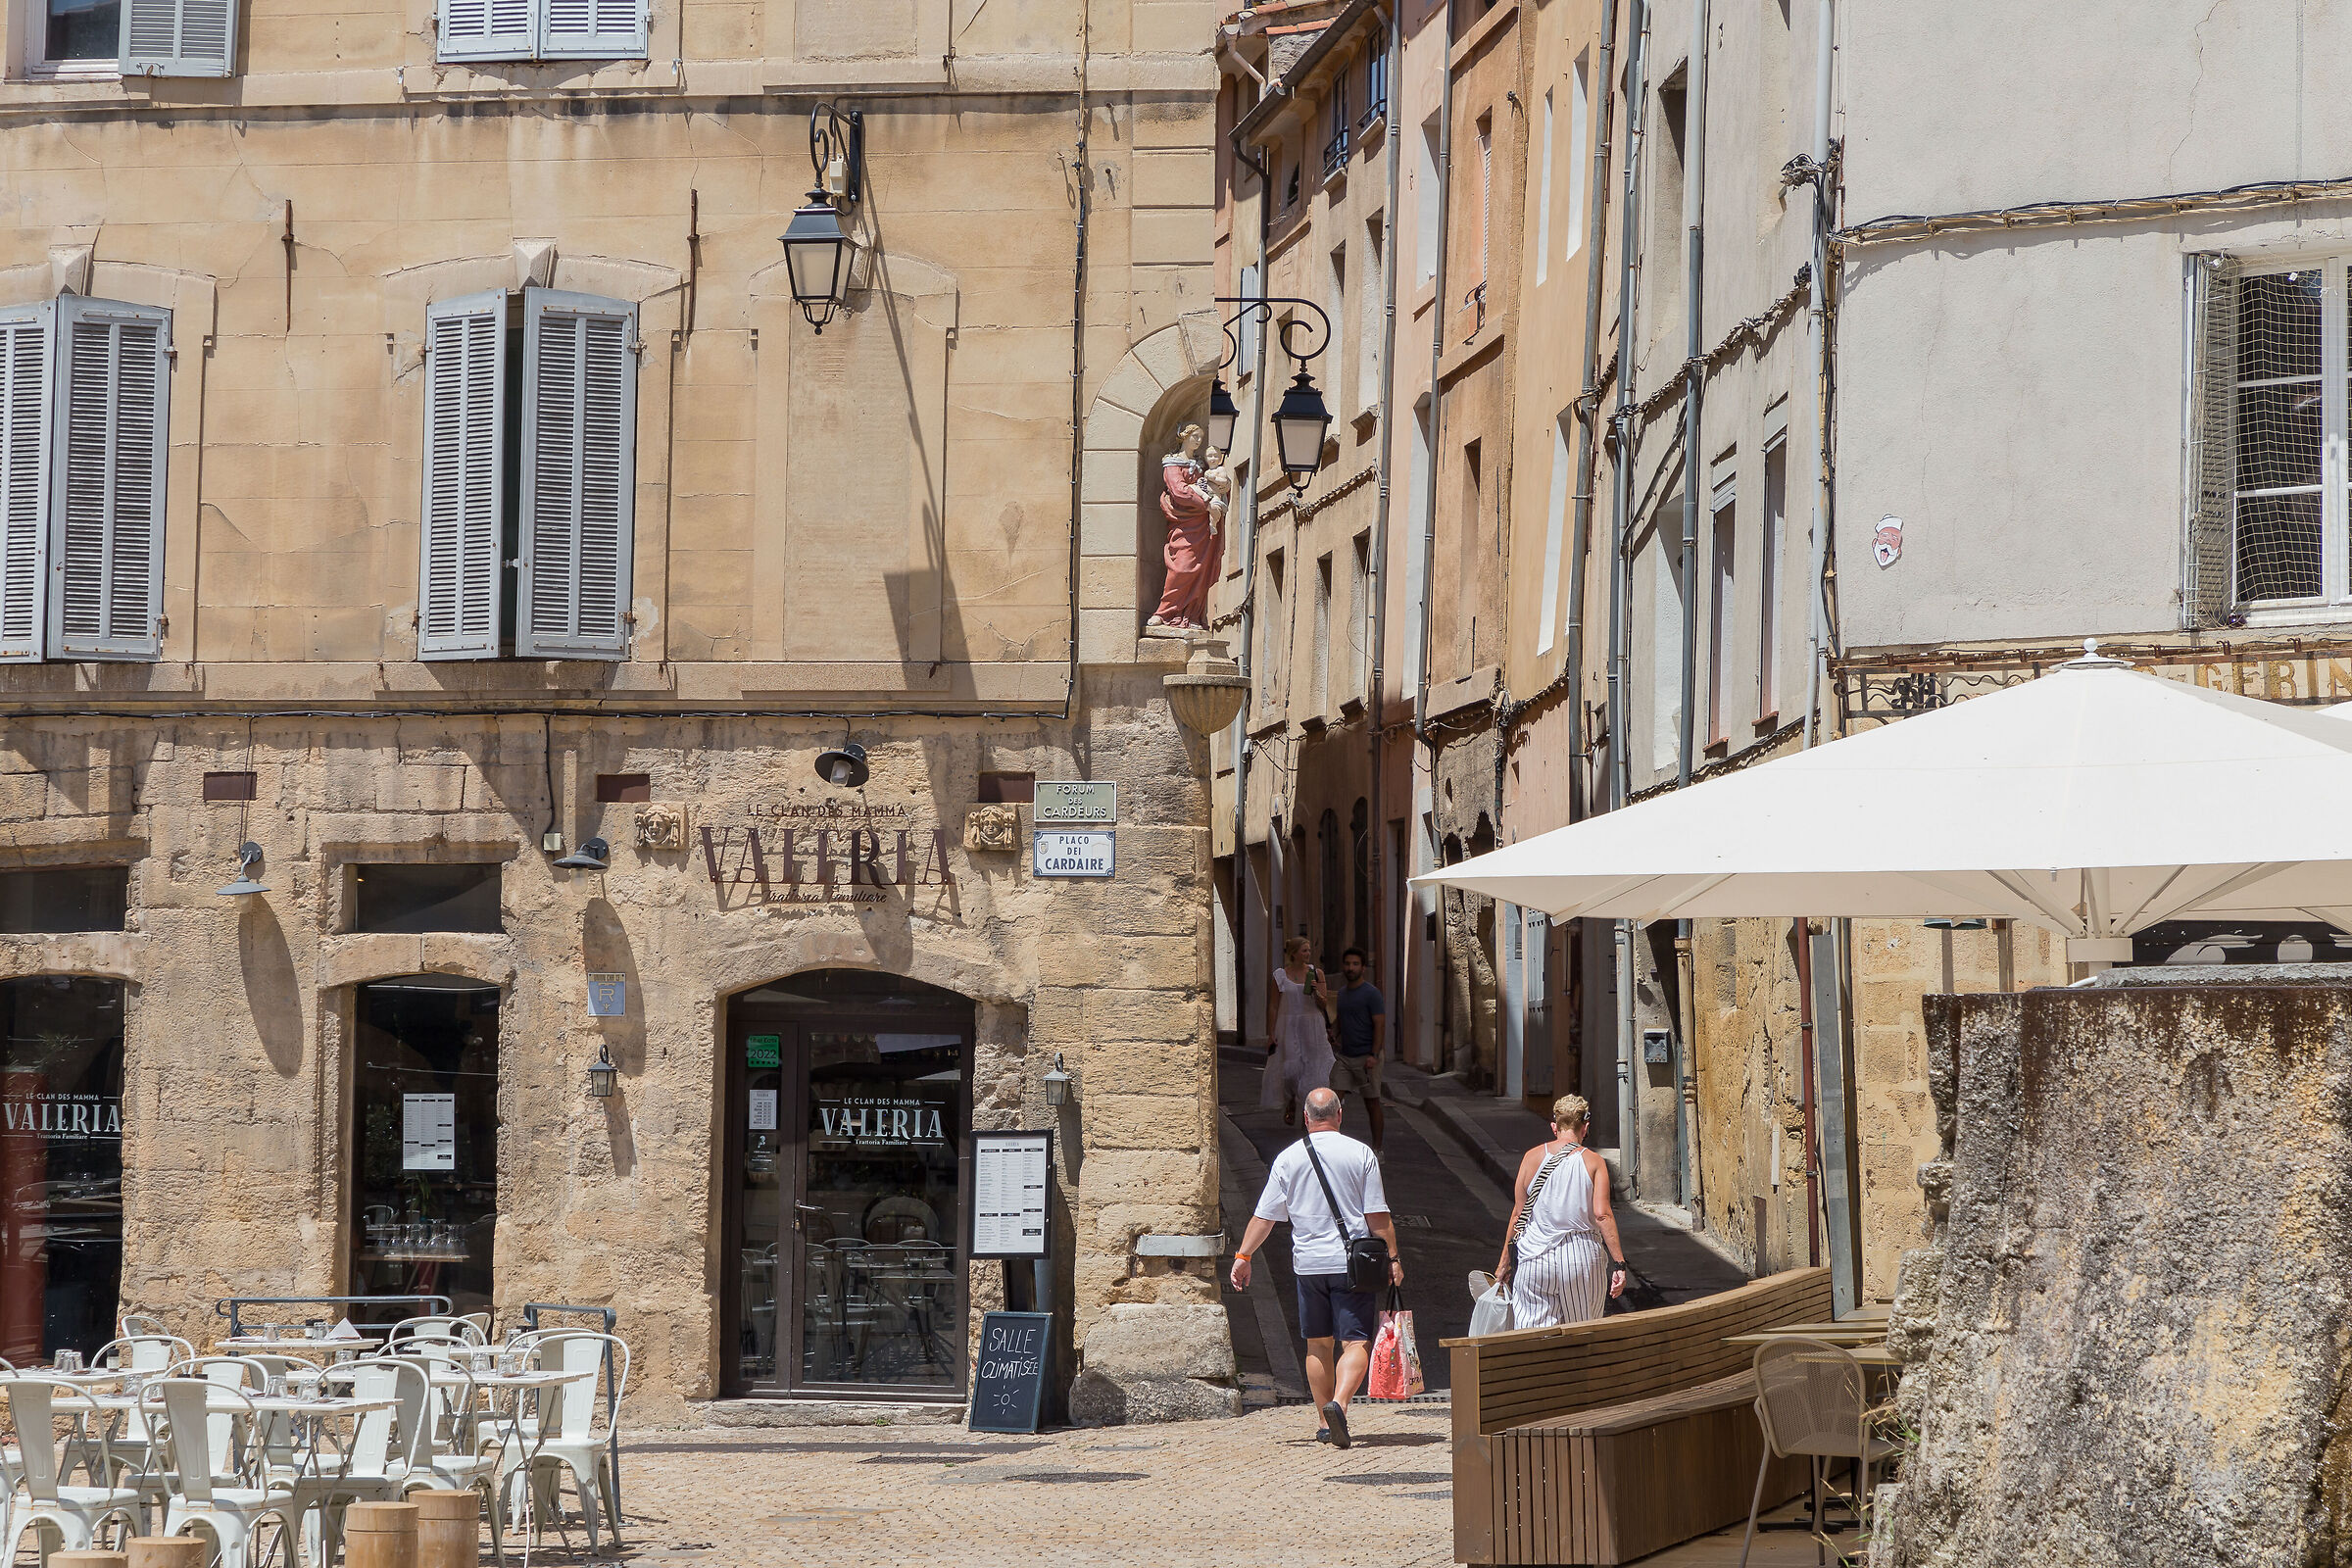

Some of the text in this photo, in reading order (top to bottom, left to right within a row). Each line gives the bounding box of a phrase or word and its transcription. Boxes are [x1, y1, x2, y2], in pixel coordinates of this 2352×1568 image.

[1056, 784, 1095, 795] FORUM
[1067, 797, 1083, 806] DES
[747, 804, 906, 817] LE CLAN DES MAMMA
[1043, 806, 1107, 818] CARDEURS
[1058, 836, 1090, 845] PLACO
[1067, 847, 1081, 856] DEI
[697, 826, 956, 890] VALERIA
[1045, 858, 1104, 870] CARDAIRE
[751, 1049, 777, 1059] 2022
[3, 1102, 122, 1134] VALERIA
[819, 1107, 945, 1140] VALERIA
[989, 1327, 1037, 1354] SALLE
